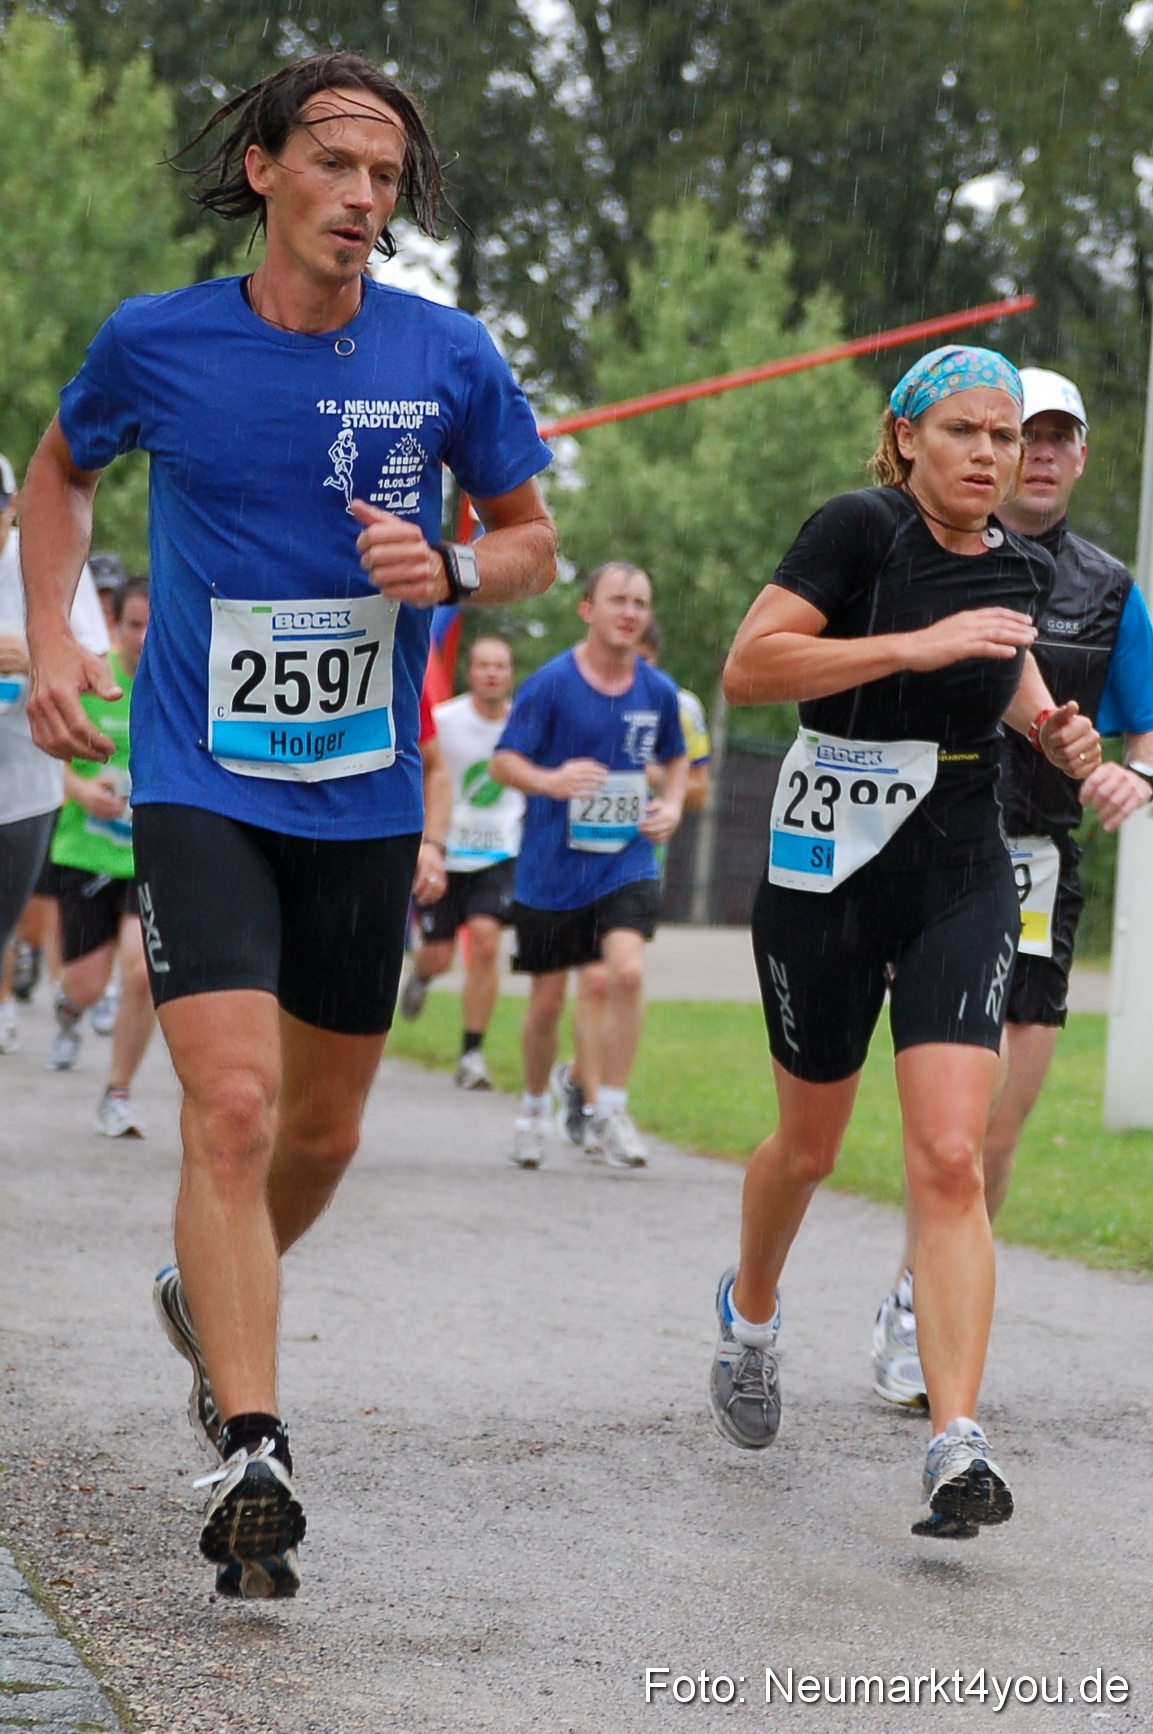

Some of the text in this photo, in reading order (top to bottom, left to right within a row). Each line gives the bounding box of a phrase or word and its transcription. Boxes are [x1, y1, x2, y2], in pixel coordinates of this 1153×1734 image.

[317, 400, 439, 416] 12. NEUMARKTER
[342, 415, 424, 429] STADTLAUF
[272, 610, 351, 630] BOCK
[1047, 620, 1079, 630] GORE
[231, 641, 380, 715] 2597
[270, 731, 346, 760] Holger
[938, 753, 979, 762] quaman
[580, 797, 640, 822] 2288
[985, 932, 1014, 1025] 2XU
